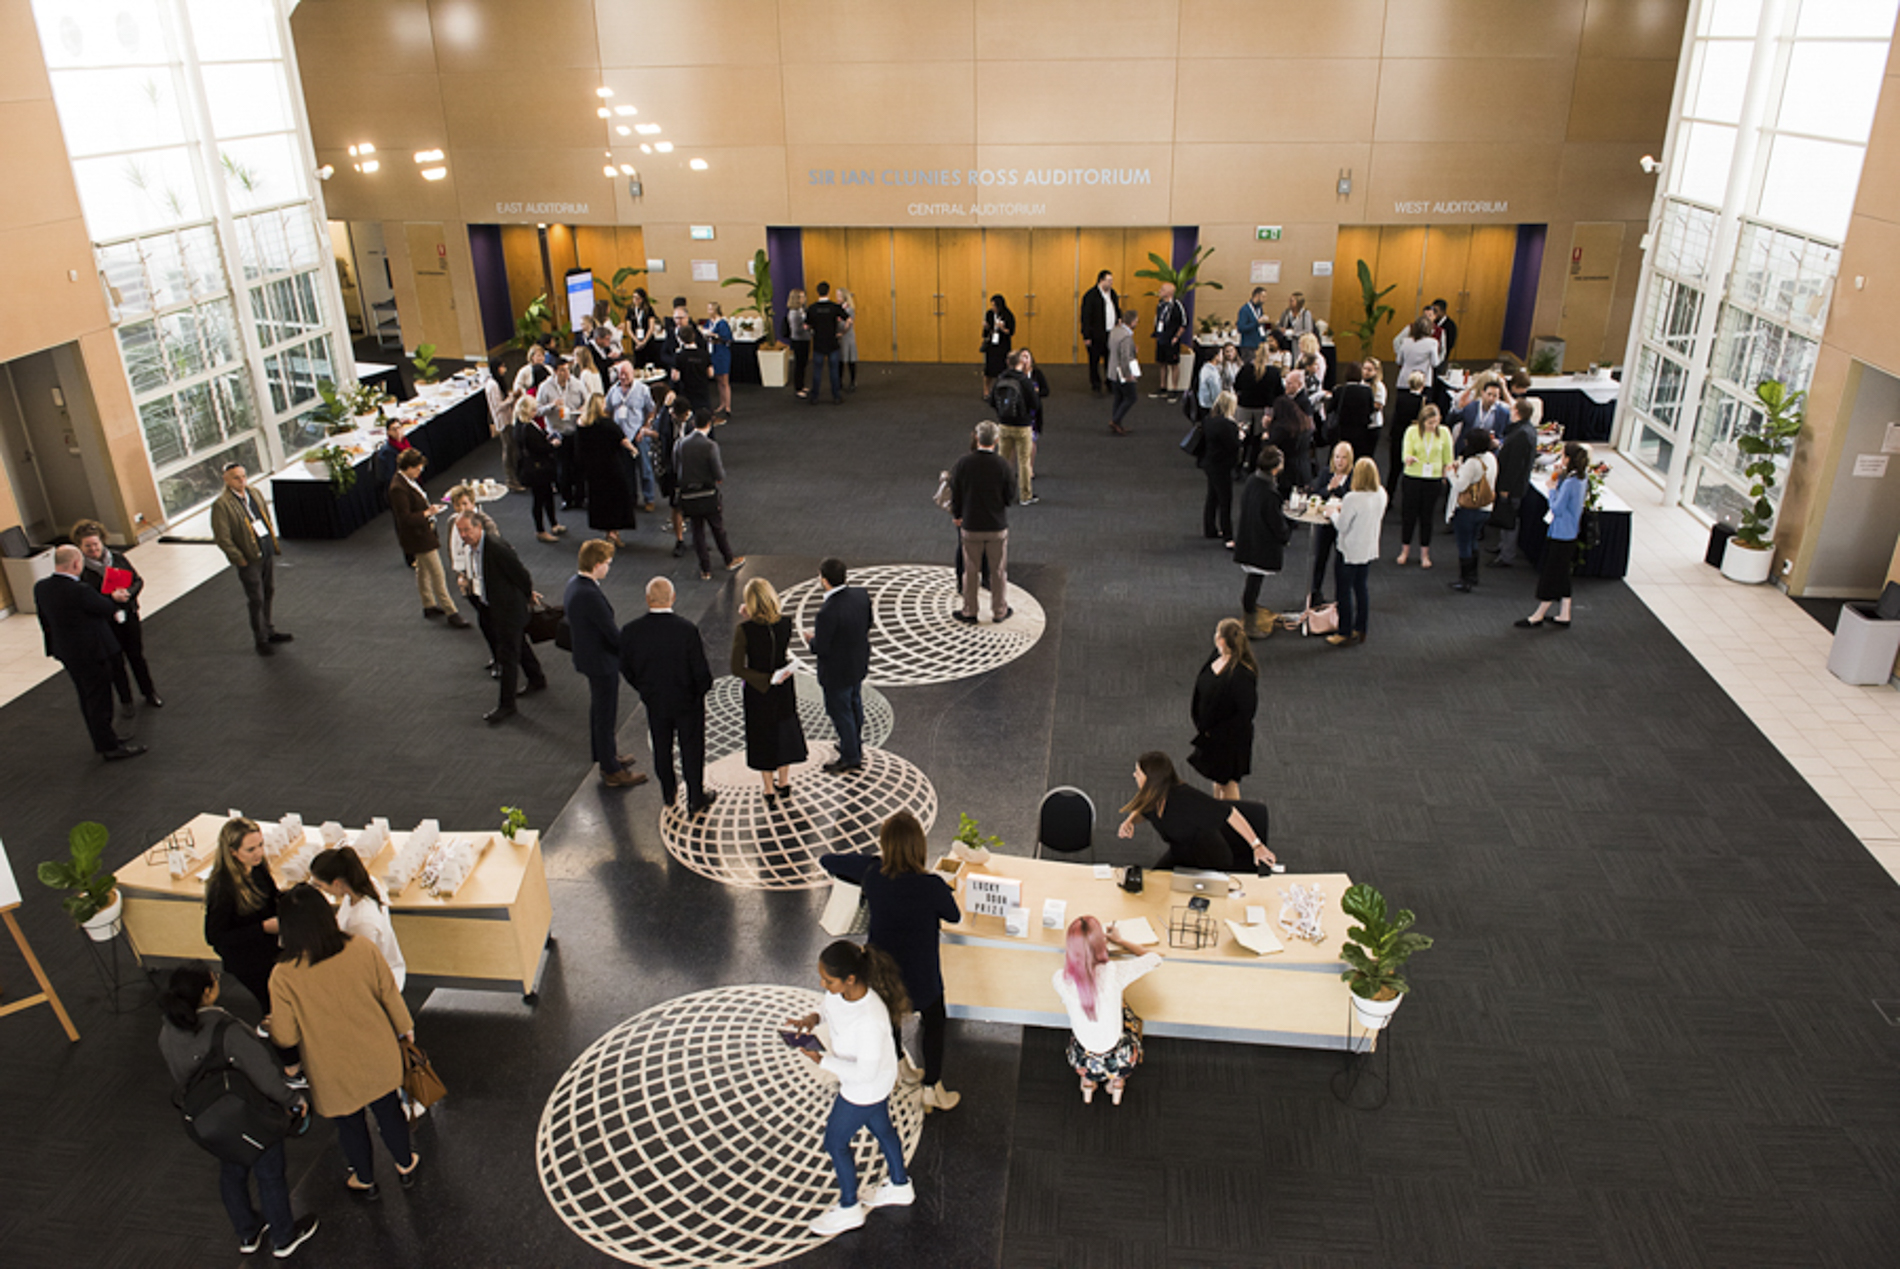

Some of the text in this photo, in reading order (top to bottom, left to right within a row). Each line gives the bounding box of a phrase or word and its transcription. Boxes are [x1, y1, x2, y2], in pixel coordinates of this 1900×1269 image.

[808, 168, 1151, 186] SIR IAN CLUNIES ROSS AUDITORIUM
[496, 201, 589, 214] EAST AUDITORIUM
[907, 202, 1047, 216] CENTRAL AUDITORIUM
[1395, 200, 1508, 214] WEST AUDITORIUM
[973, 881, 999, 892] LUCKY
